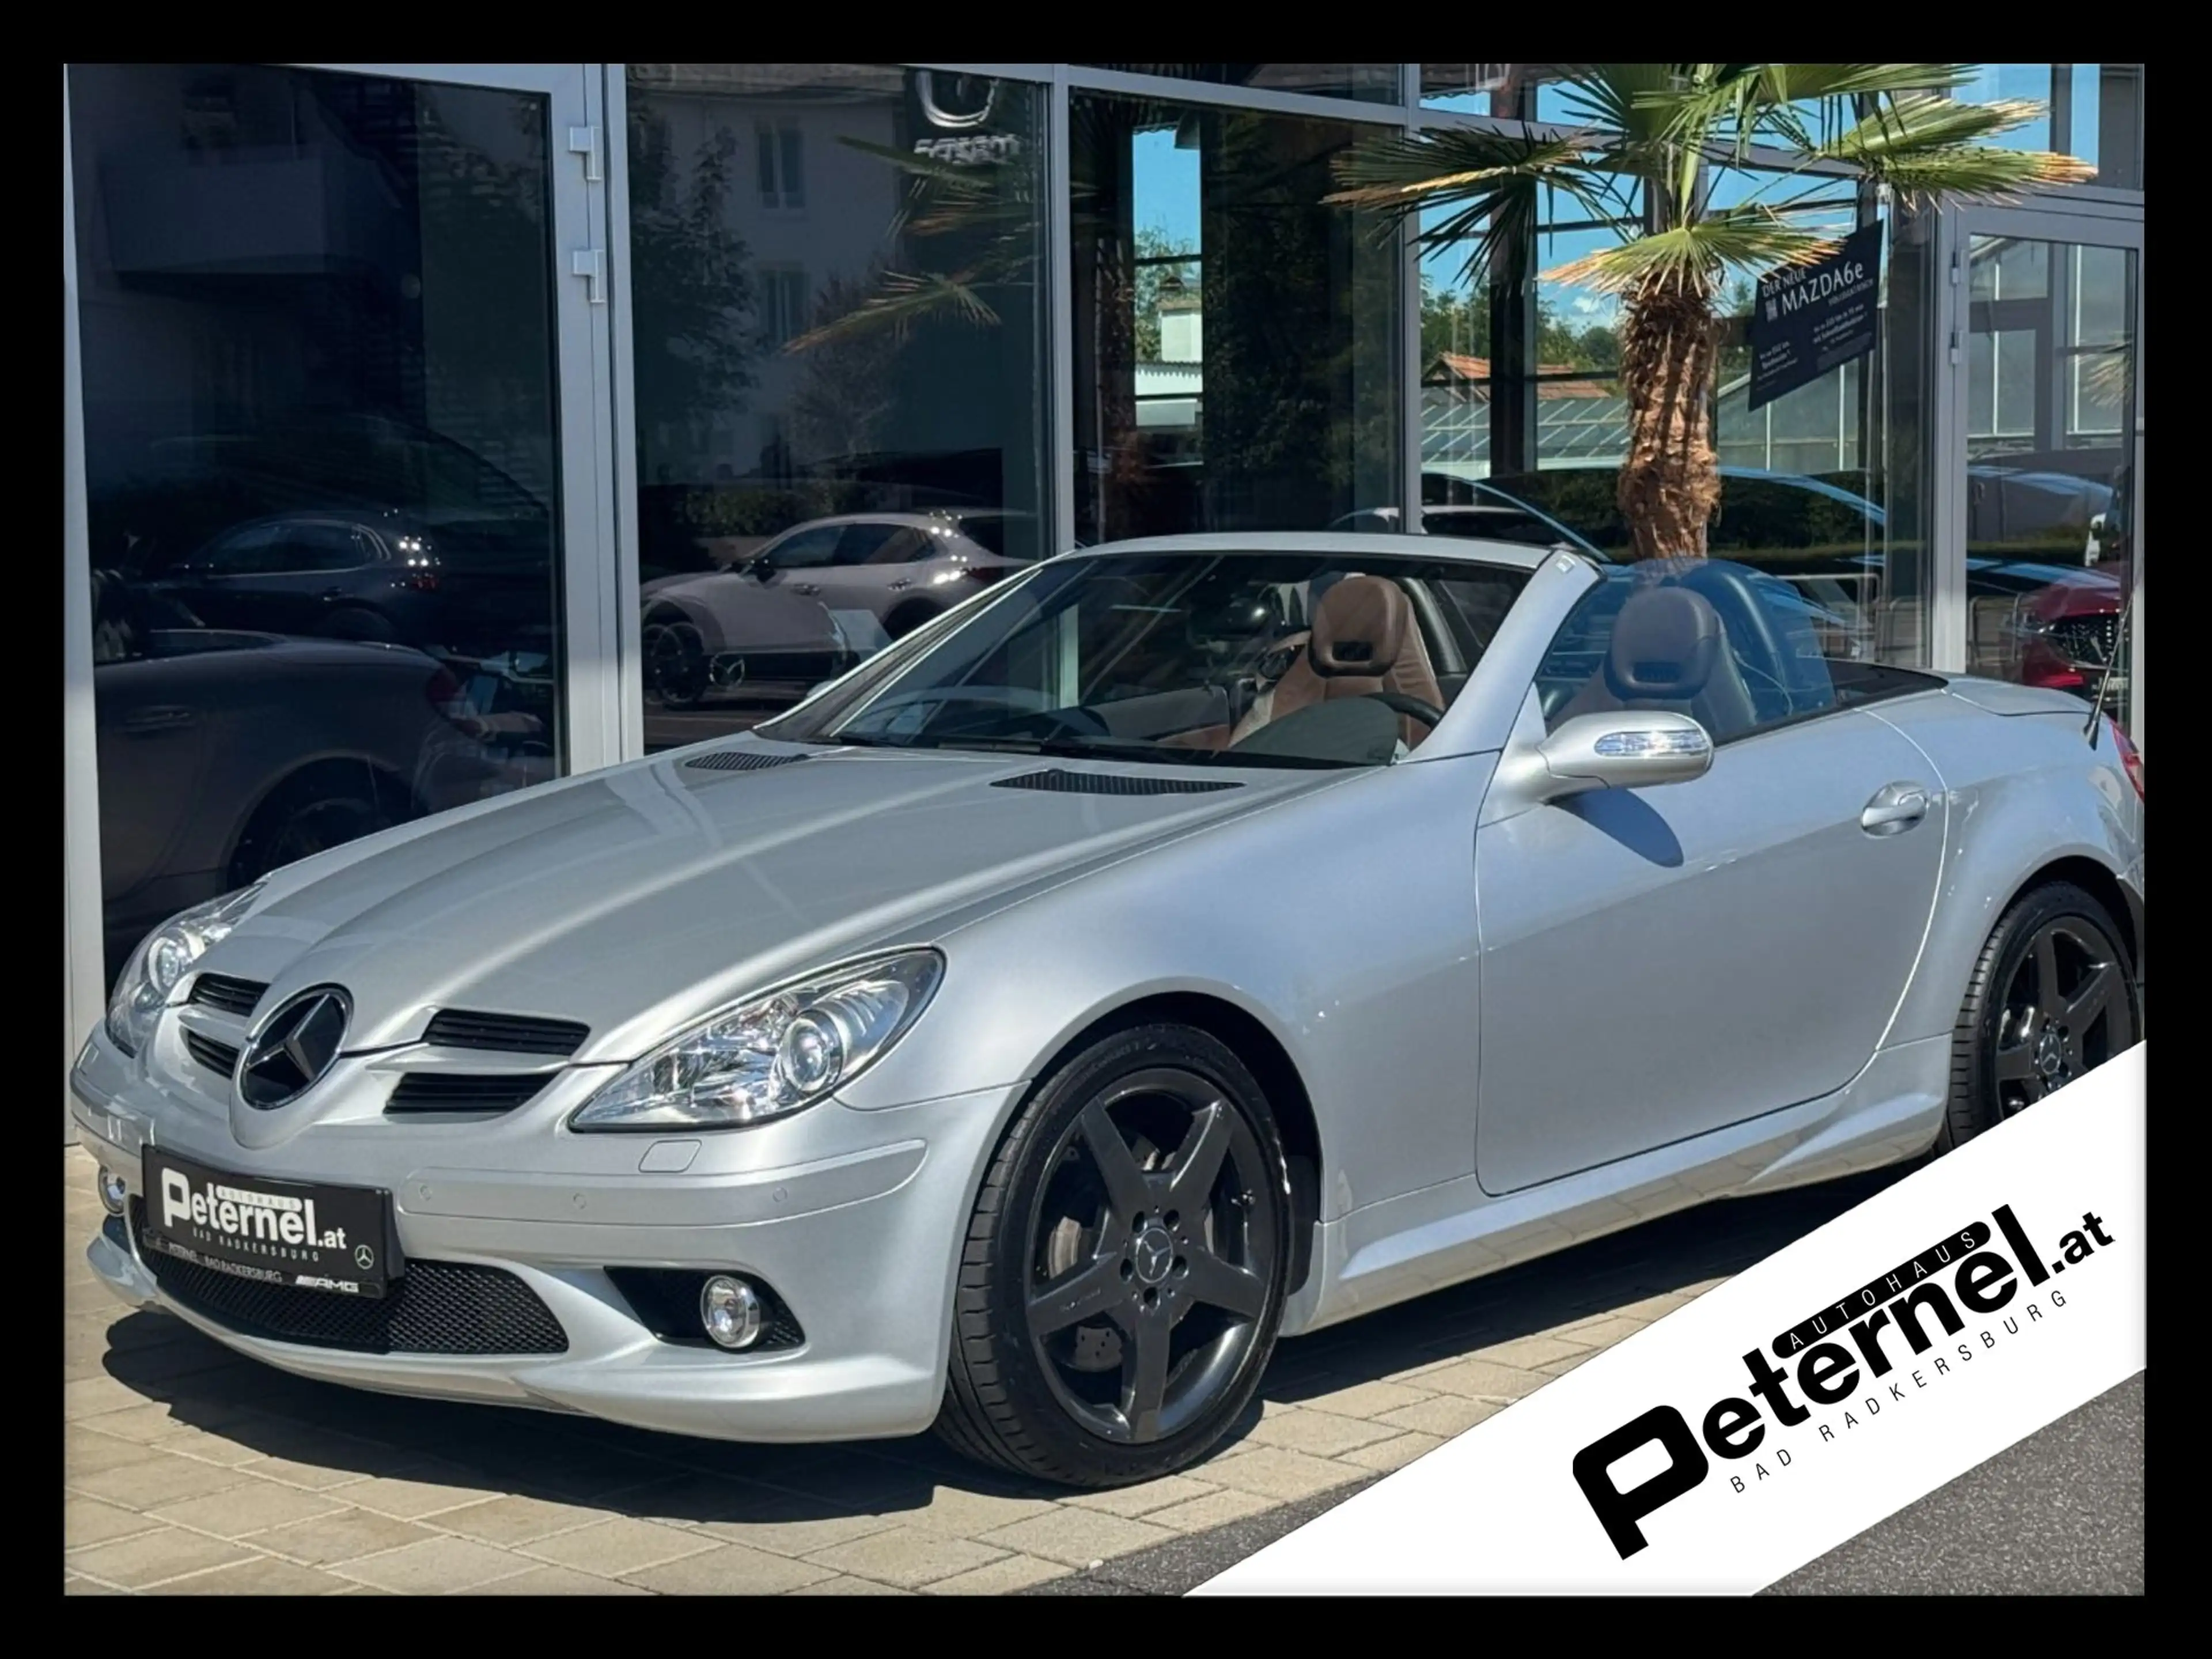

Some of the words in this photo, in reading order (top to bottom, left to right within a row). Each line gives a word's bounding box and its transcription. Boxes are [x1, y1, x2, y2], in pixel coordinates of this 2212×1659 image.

[1762, 280, 1781, 297] DER
[1782, 261, 1864, 316] MAZDA6e
[162, 1167, 347, 1249] Peternel.at
